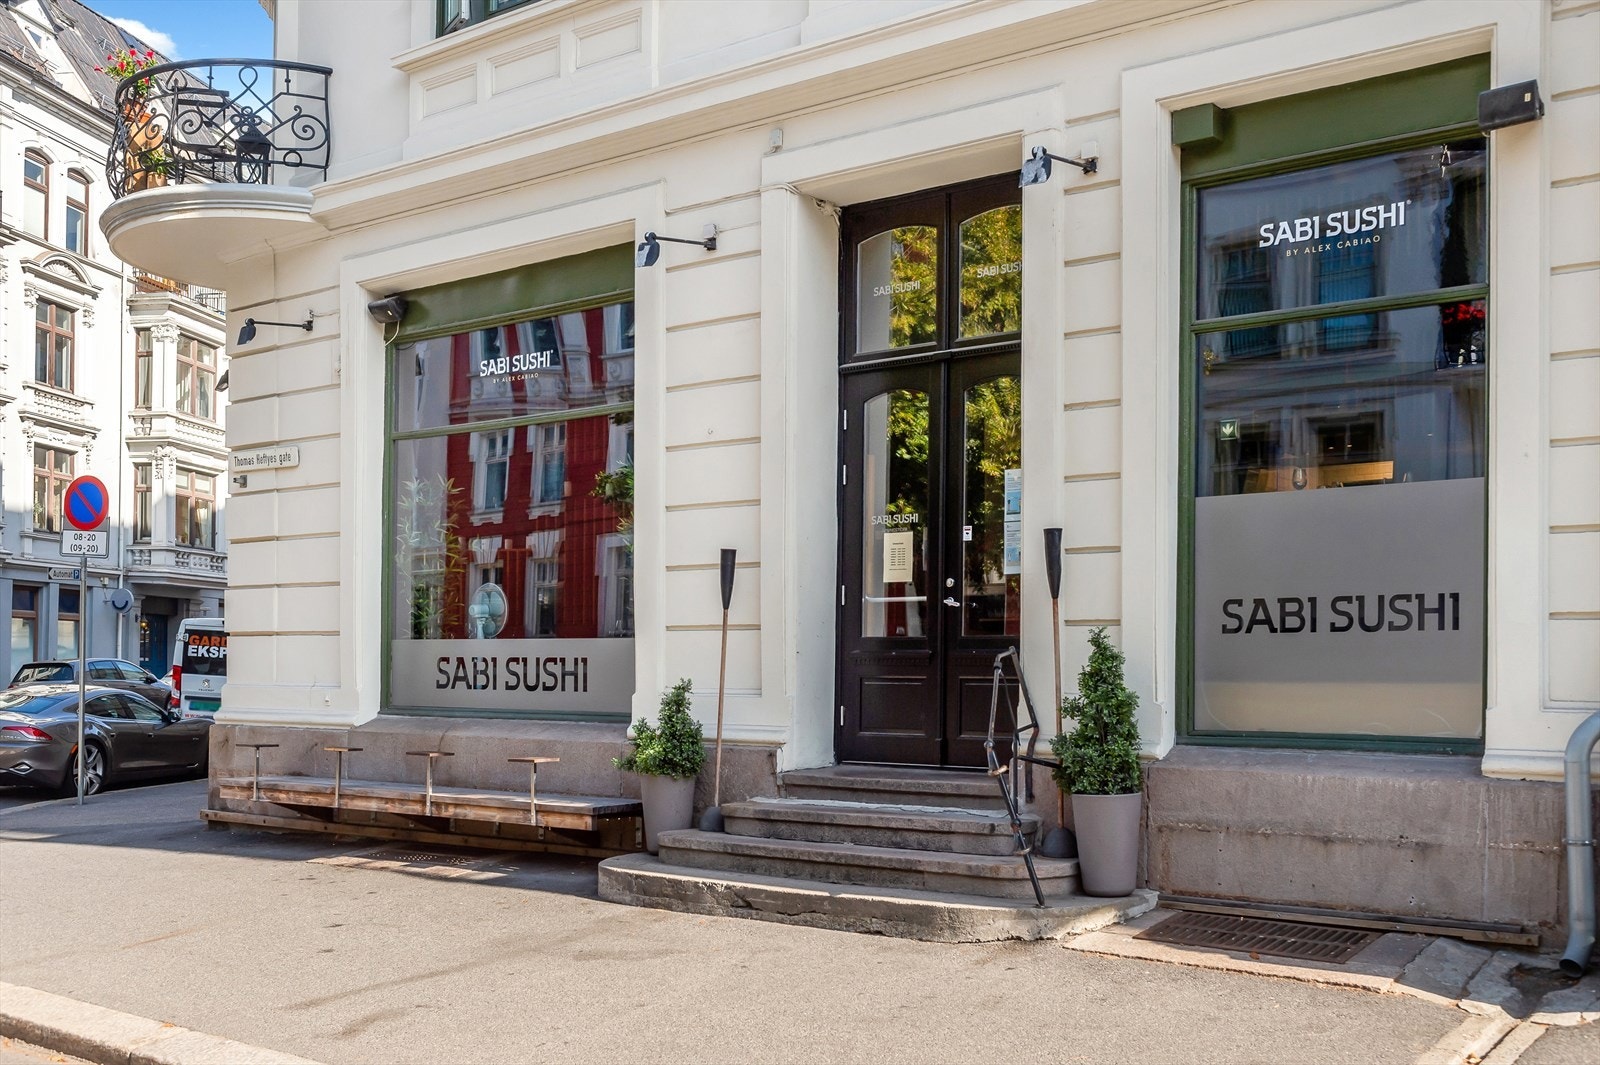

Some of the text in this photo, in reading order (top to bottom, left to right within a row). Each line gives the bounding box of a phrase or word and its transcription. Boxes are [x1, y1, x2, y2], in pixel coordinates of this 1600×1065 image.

[1258, 201, 1406, 248] SABI SUSHI
[1286, 234, 1381, 257] BY ALEX CABIAO
[976, 265, 999, 278] SABI
[873, 280, 921, 297] SABI SUSHI
[480, 350, 551, 377] SABI SUSHI
[517, 372, 539, 381] CABIAO
[233, 455, 255, 467] Thomas
[278, 451, 291, 466] gate
[871, 513, 919, 526] SABI SUSHI
[73, 533, 96, 542] 08-20
[70, 543, 99, 554] (09-20)
[1221, 592, 1460, 635] SABI SUSHI
[436, 656, 588, 693] SABI SUSHI
